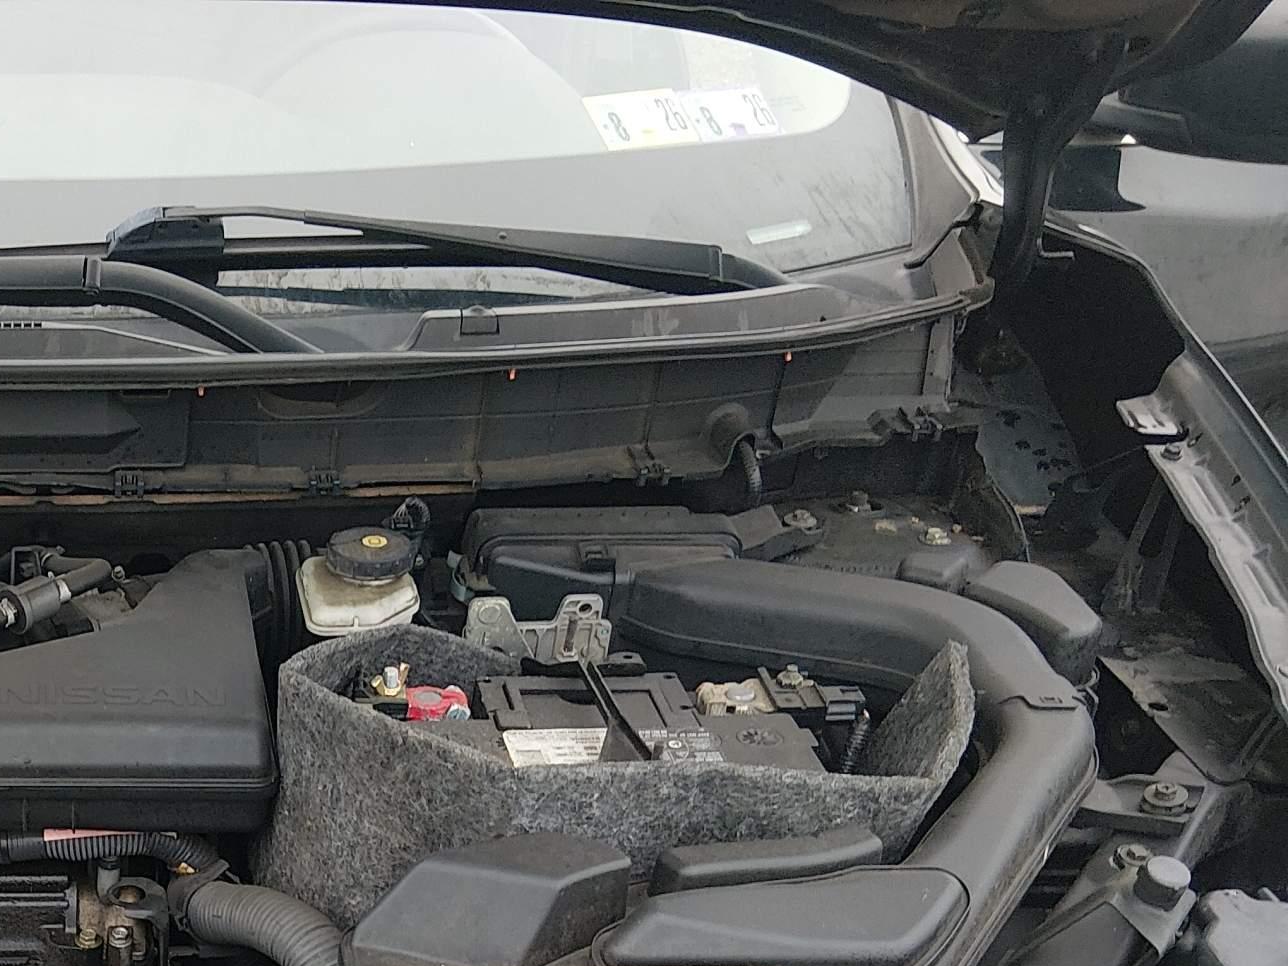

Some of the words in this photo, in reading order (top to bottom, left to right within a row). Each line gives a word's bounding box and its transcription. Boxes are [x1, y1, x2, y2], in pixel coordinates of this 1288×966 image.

[654, 97, 688, 131] 26
[741, 94, 776, 126] 26
[0, 686, 226, 706] NISSAN
